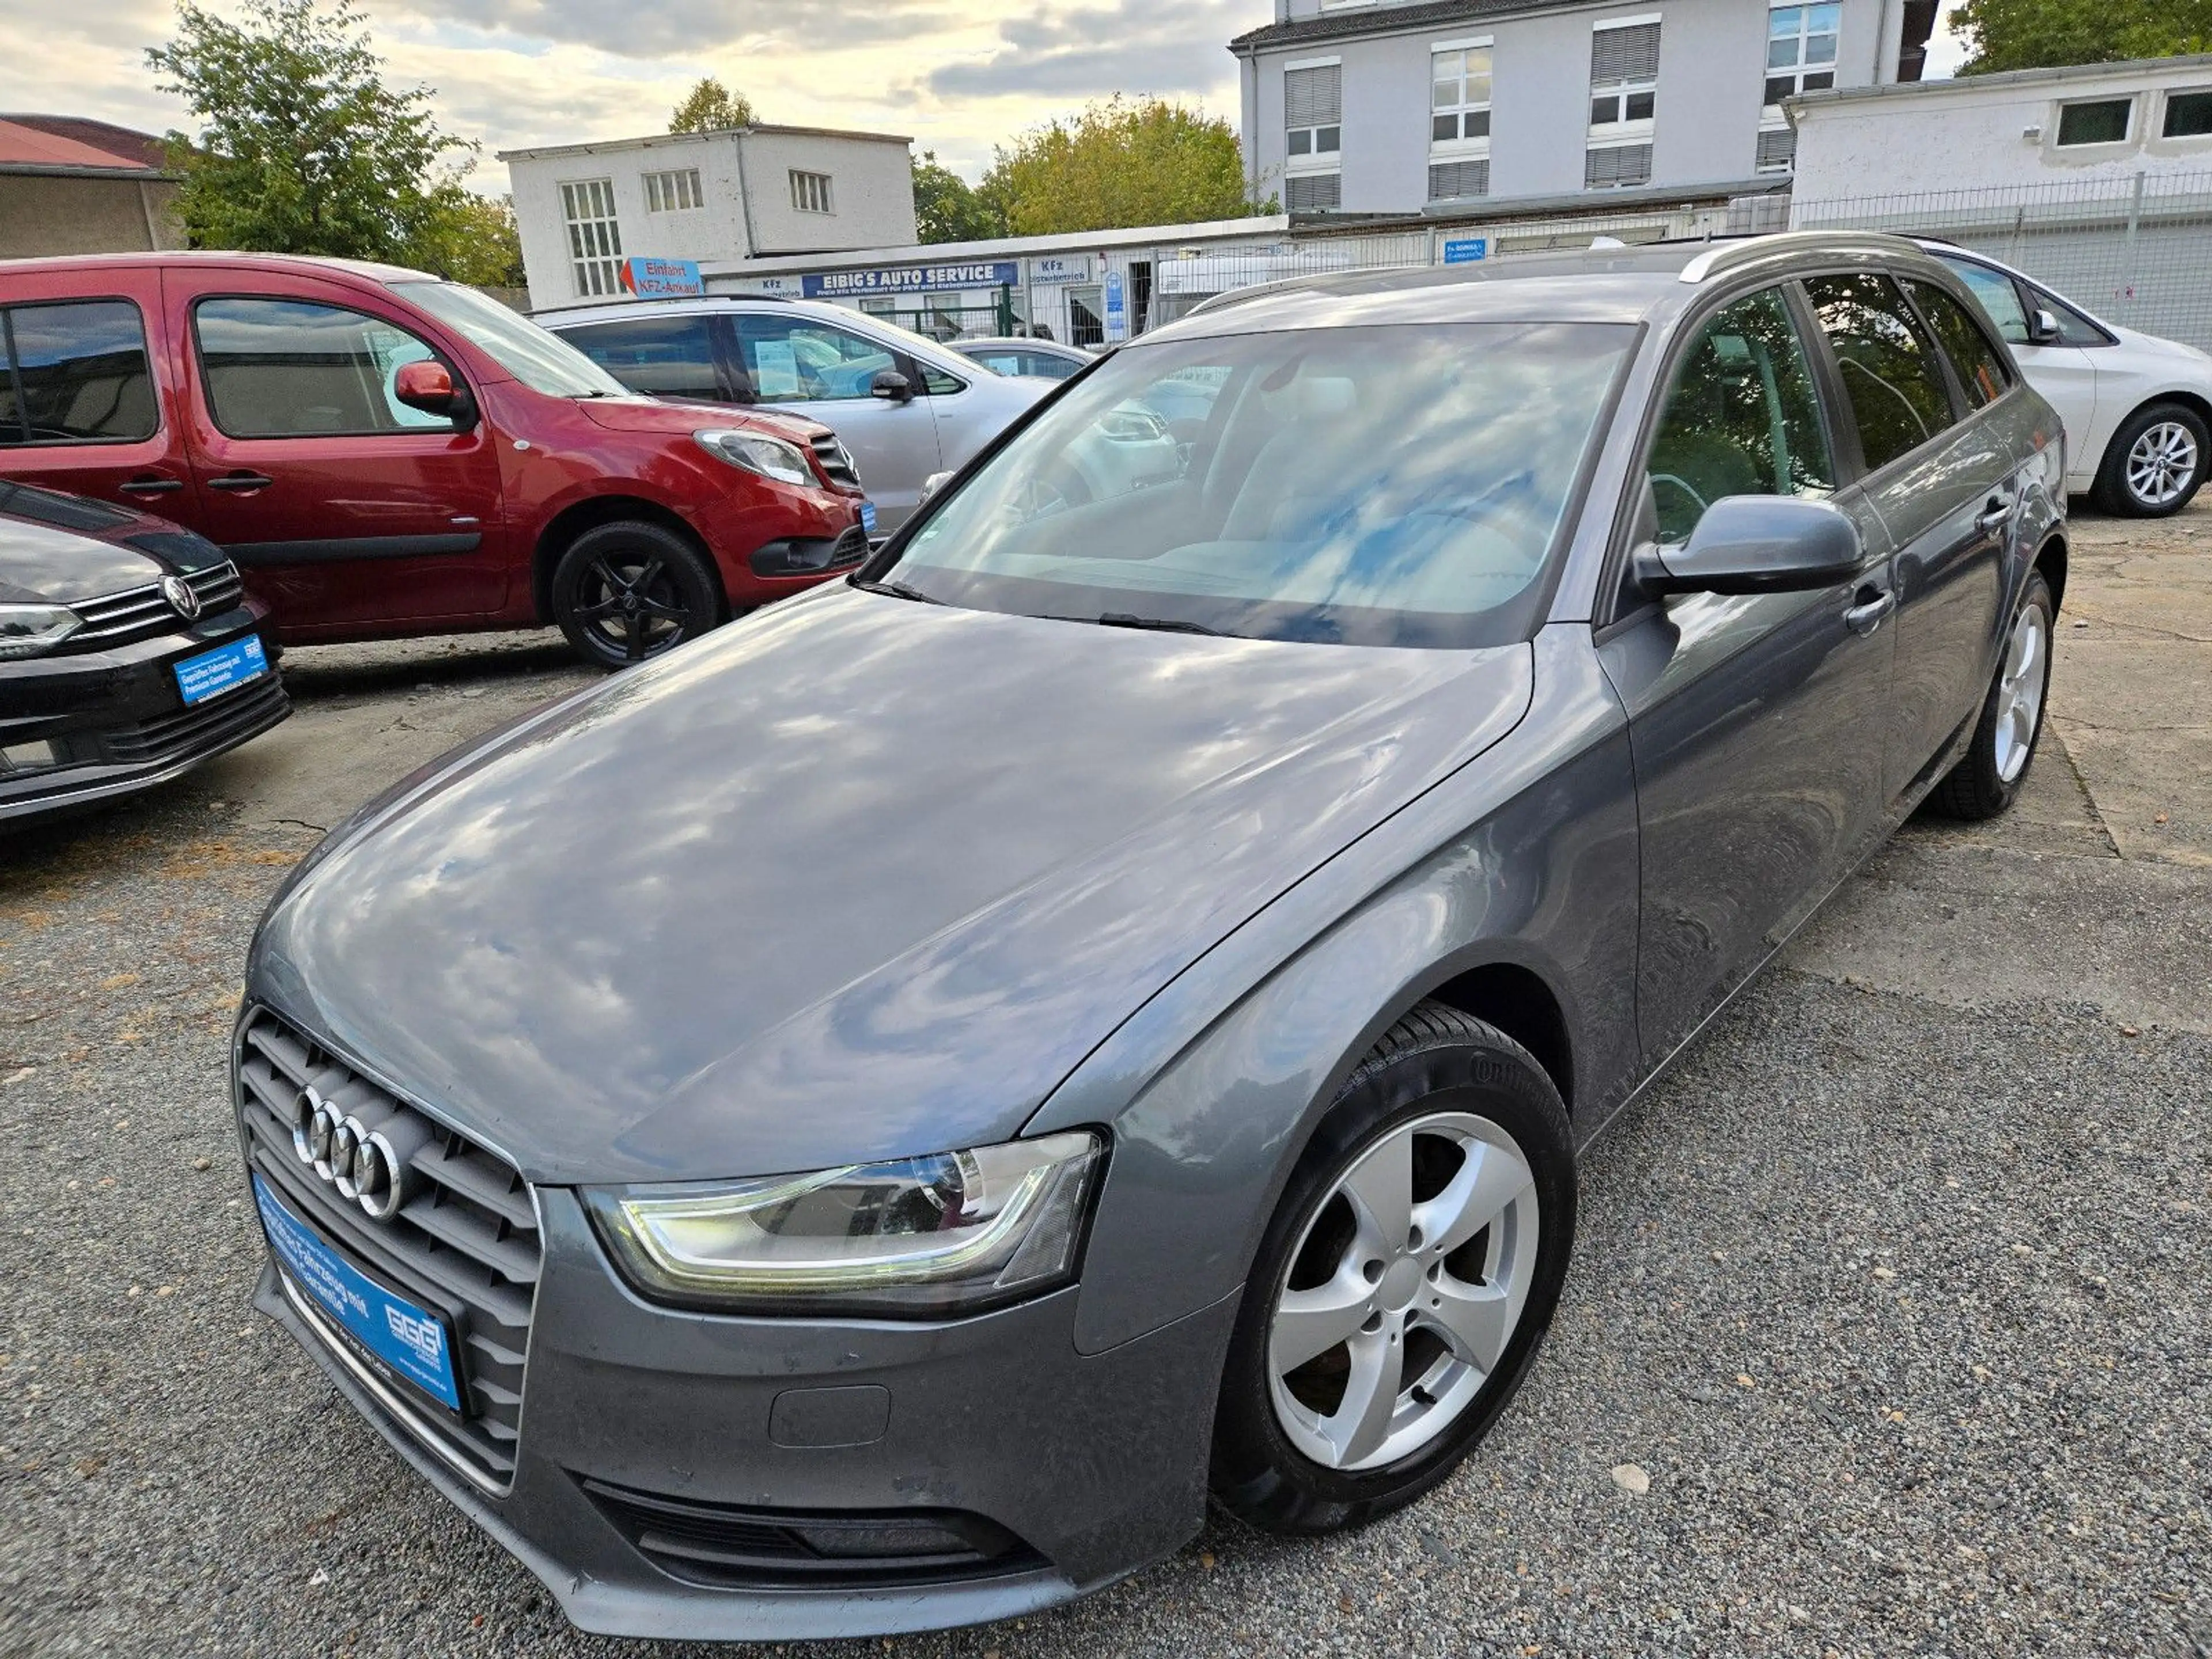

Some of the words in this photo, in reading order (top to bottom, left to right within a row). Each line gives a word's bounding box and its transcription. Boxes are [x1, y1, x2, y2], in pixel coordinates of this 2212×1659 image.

[646, 263, 687, 276] Einfahrt
[1041, 260, 1063, 272] Kfz
[880, 270, 922, 286] AUTO
[926, 265, 994, 283] SERVICE
[638, 279, 700, 294] KFZ-Ankauf
[763, 279, 781, 289] Kfz
[347, 1290, 369, 1319] mit
